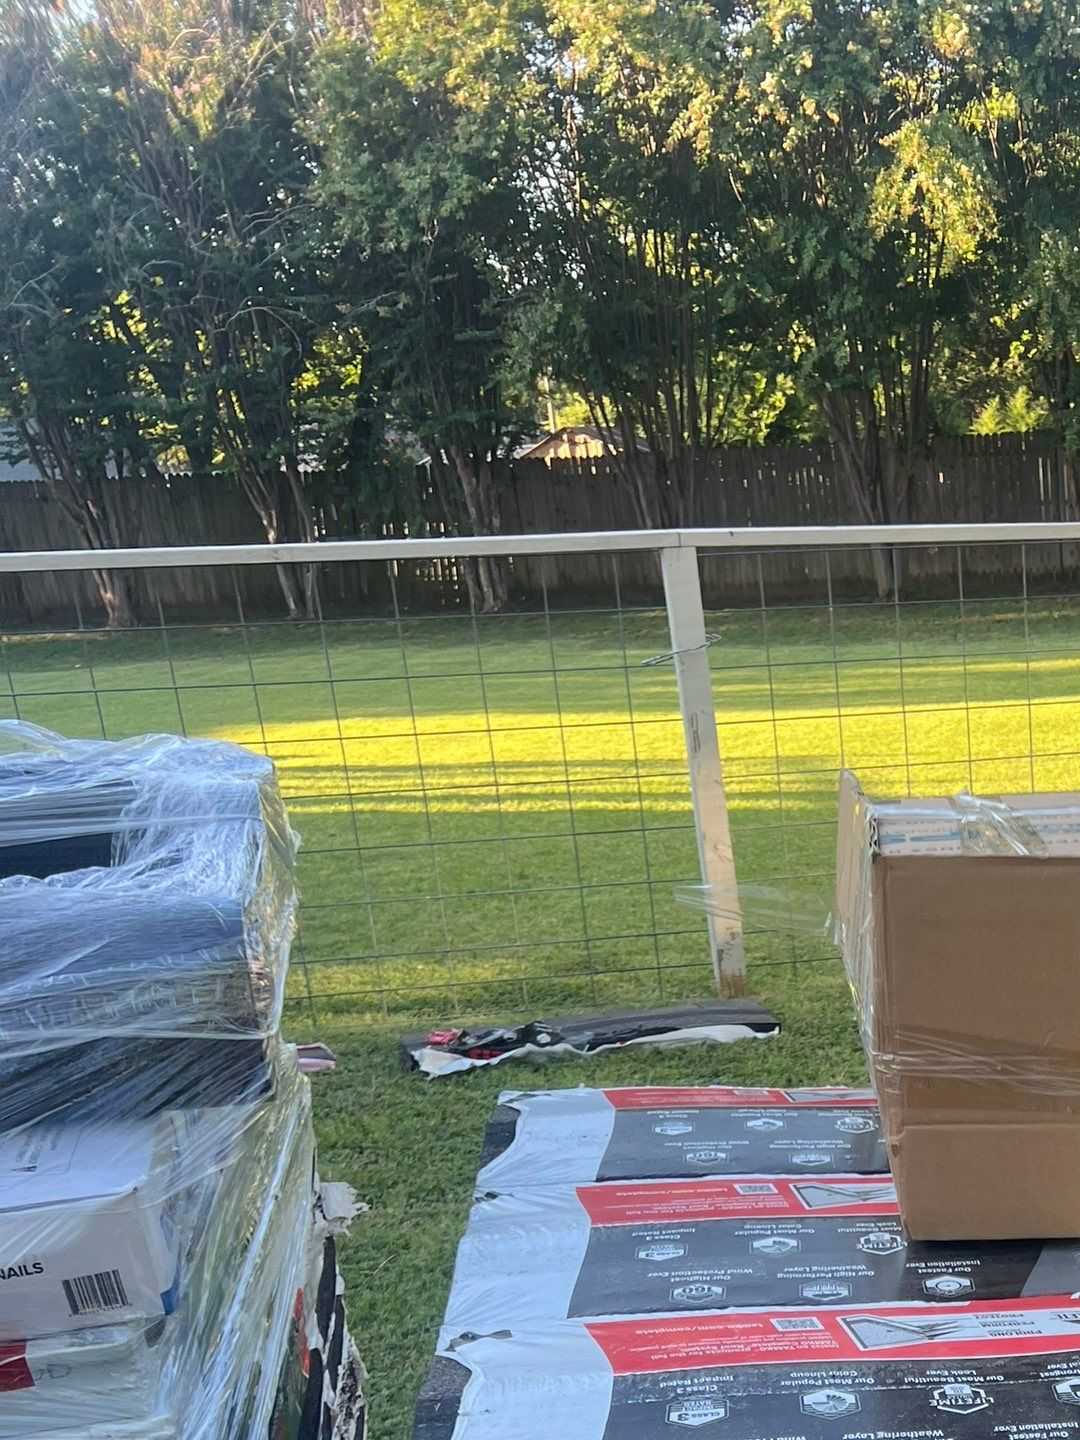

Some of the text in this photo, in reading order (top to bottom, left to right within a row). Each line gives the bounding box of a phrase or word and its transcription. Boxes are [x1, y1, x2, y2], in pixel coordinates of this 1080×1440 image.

[671, 1269, 725, 1277] Protection
[635, 1322, 764, 1335] tamko.com/complete
[1047, 1363, 1071, 1371] Ever
[829, 1370, 858, 1379] Color
[660, 1374, 734, 1389] Impact Rated
[780, 1377, 823, 1387] Popular
[904, 1376, 955, 1384] Beautiful
[689, 1384, 718, 1393] Class
[929, 1397, 994, 1406] LIFETIME
[677, 1413, 690, 1422] 3
[994, 1421, 1079, 1433] Installation Ever
[876, 1429, 944, 1440] Weathering
[1049, 1431, 1069, 1439] Our
